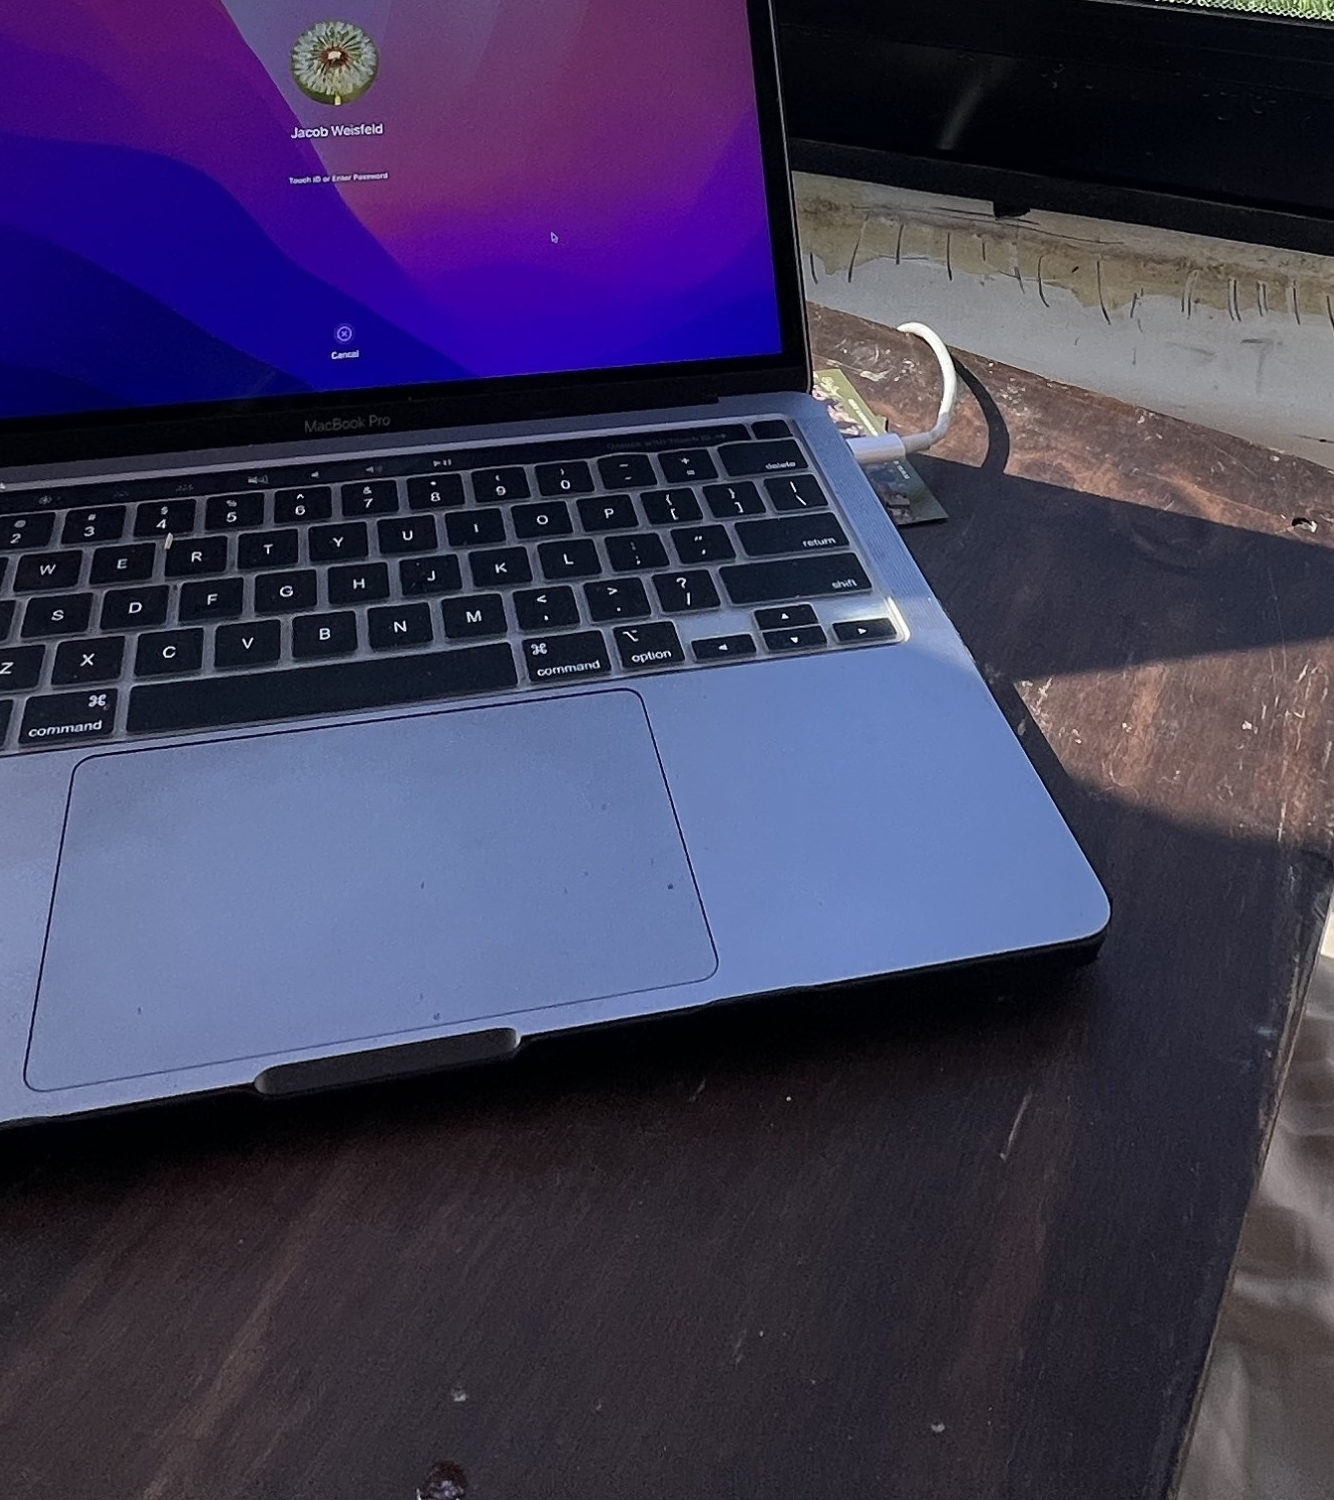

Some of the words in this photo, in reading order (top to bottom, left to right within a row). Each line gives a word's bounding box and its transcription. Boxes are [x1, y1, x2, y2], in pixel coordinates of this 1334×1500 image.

[291, 126, 328, 139] Jacob
[331, 123, 384, 137] Weisfeld
[304, 416, 366, 434] MacBook
[369, 414, 392, 428] Pro
[494, 485, 506, 497] 9
[559, 479, 571, 491] 0
[362, 497, 373, 509] 7
[430, 491, 441, 503] 8
[292, 504, 305, 517] 6
[603, 507, 614, 519] P
[225, 510, 237, 524] 5
[536, 515, 548, 526] O
[155, 517, 167, 530] 4
[83, 525, 95, 538] 3
[401, 529, 413, 541] U
[9, 532, 21, 545] 2
[333, 536, 344, 547] Y
[802, 536, 837, 547] return
[262, 543, 273, 555] T
[190, 550, 202, 563] R
[563, 553, 574, 565] L
[40, 564, 56, 576] W
[117, 558, 128, 570] E
[495, 561, 507, 574] K
[426, 569, 436, 581] J
[352, 578, 365, 590] H
[831, 578, 858, 590] shift
[279, 585, 293, 598] G
[206, 592, 218, 605] F
[128, 602, 142, 614] D
[51, 609, 64, 621] S
[466, 610, 482, 623] M
[393, 620, 407, 633] N
[319, 628, 331, 640] B
[241, 635, 254, 649] V
[162, 646, 176, 658] C
[631, 650, 672, 663] option
[80, 652, 95, 666] X
[537, 660, 601, 677] command
[28, 719, 103, 738] command
